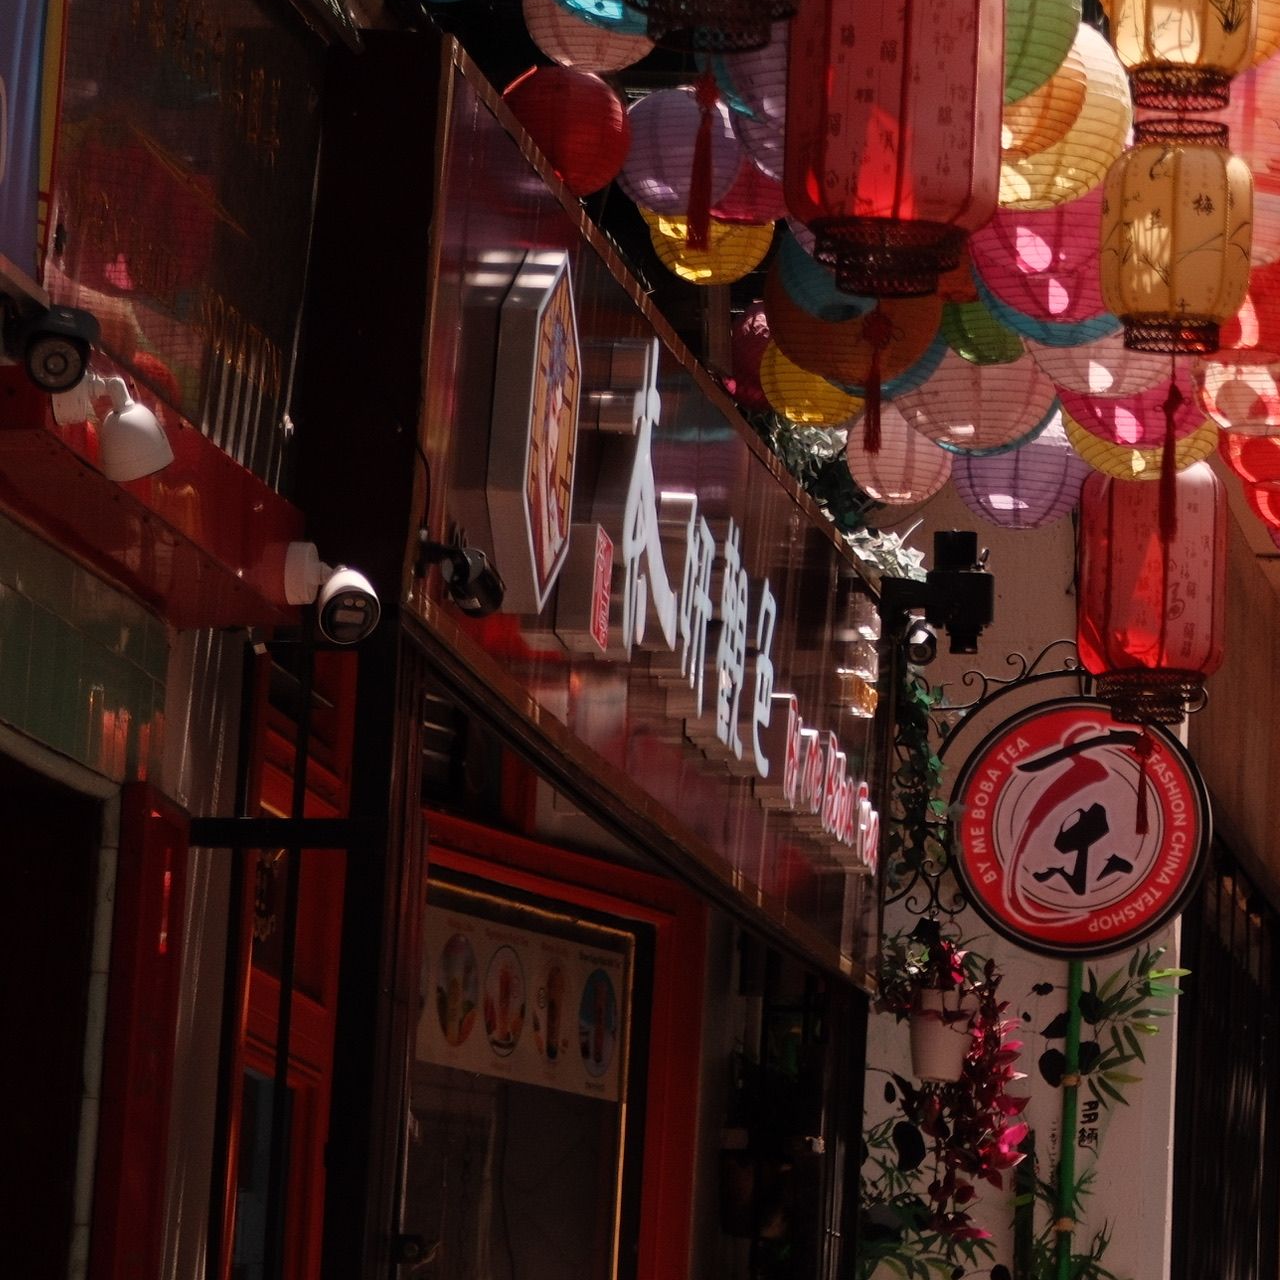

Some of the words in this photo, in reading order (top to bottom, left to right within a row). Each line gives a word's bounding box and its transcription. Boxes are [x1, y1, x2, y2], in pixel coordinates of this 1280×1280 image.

[996, 736, 1032, 767] TEA
[971, 766, 1004, 821] BOBA
[1146, 752, 1189, 828] FASHION
[970, 825, 988, 854] ME
[1155, 831, 1187, 885] CHINA
[975, 862, 999, 885] BY
[1087, 883, 1164, 934] TEASHOP
